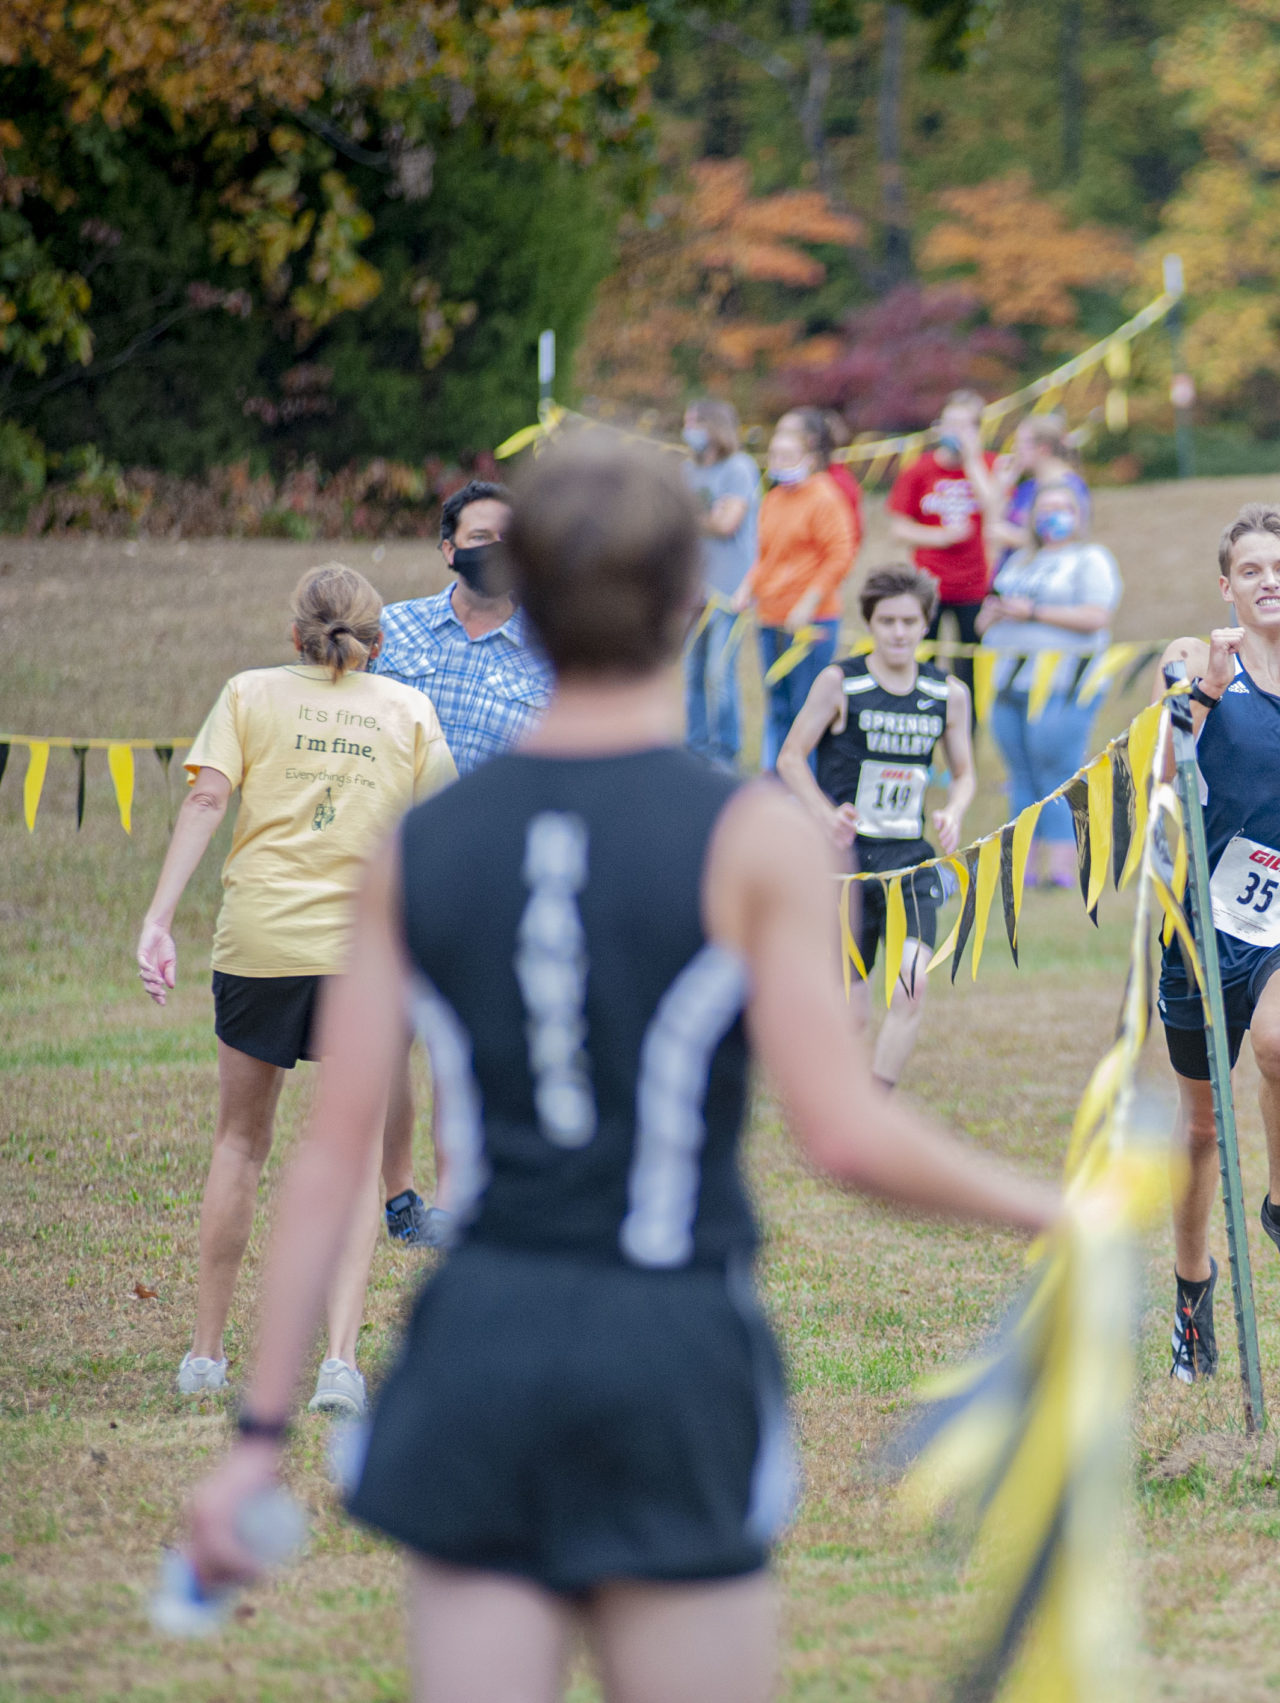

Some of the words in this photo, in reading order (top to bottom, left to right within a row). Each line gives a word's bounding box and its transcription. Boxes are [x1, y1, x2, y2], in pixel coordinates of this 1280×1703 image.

[336, 708, 381, 732] fine.
[294, 733, 327, 753] I'm
[866, 731, 936, 757] VALLEY
[1236, 871, 1280, 913] 35
